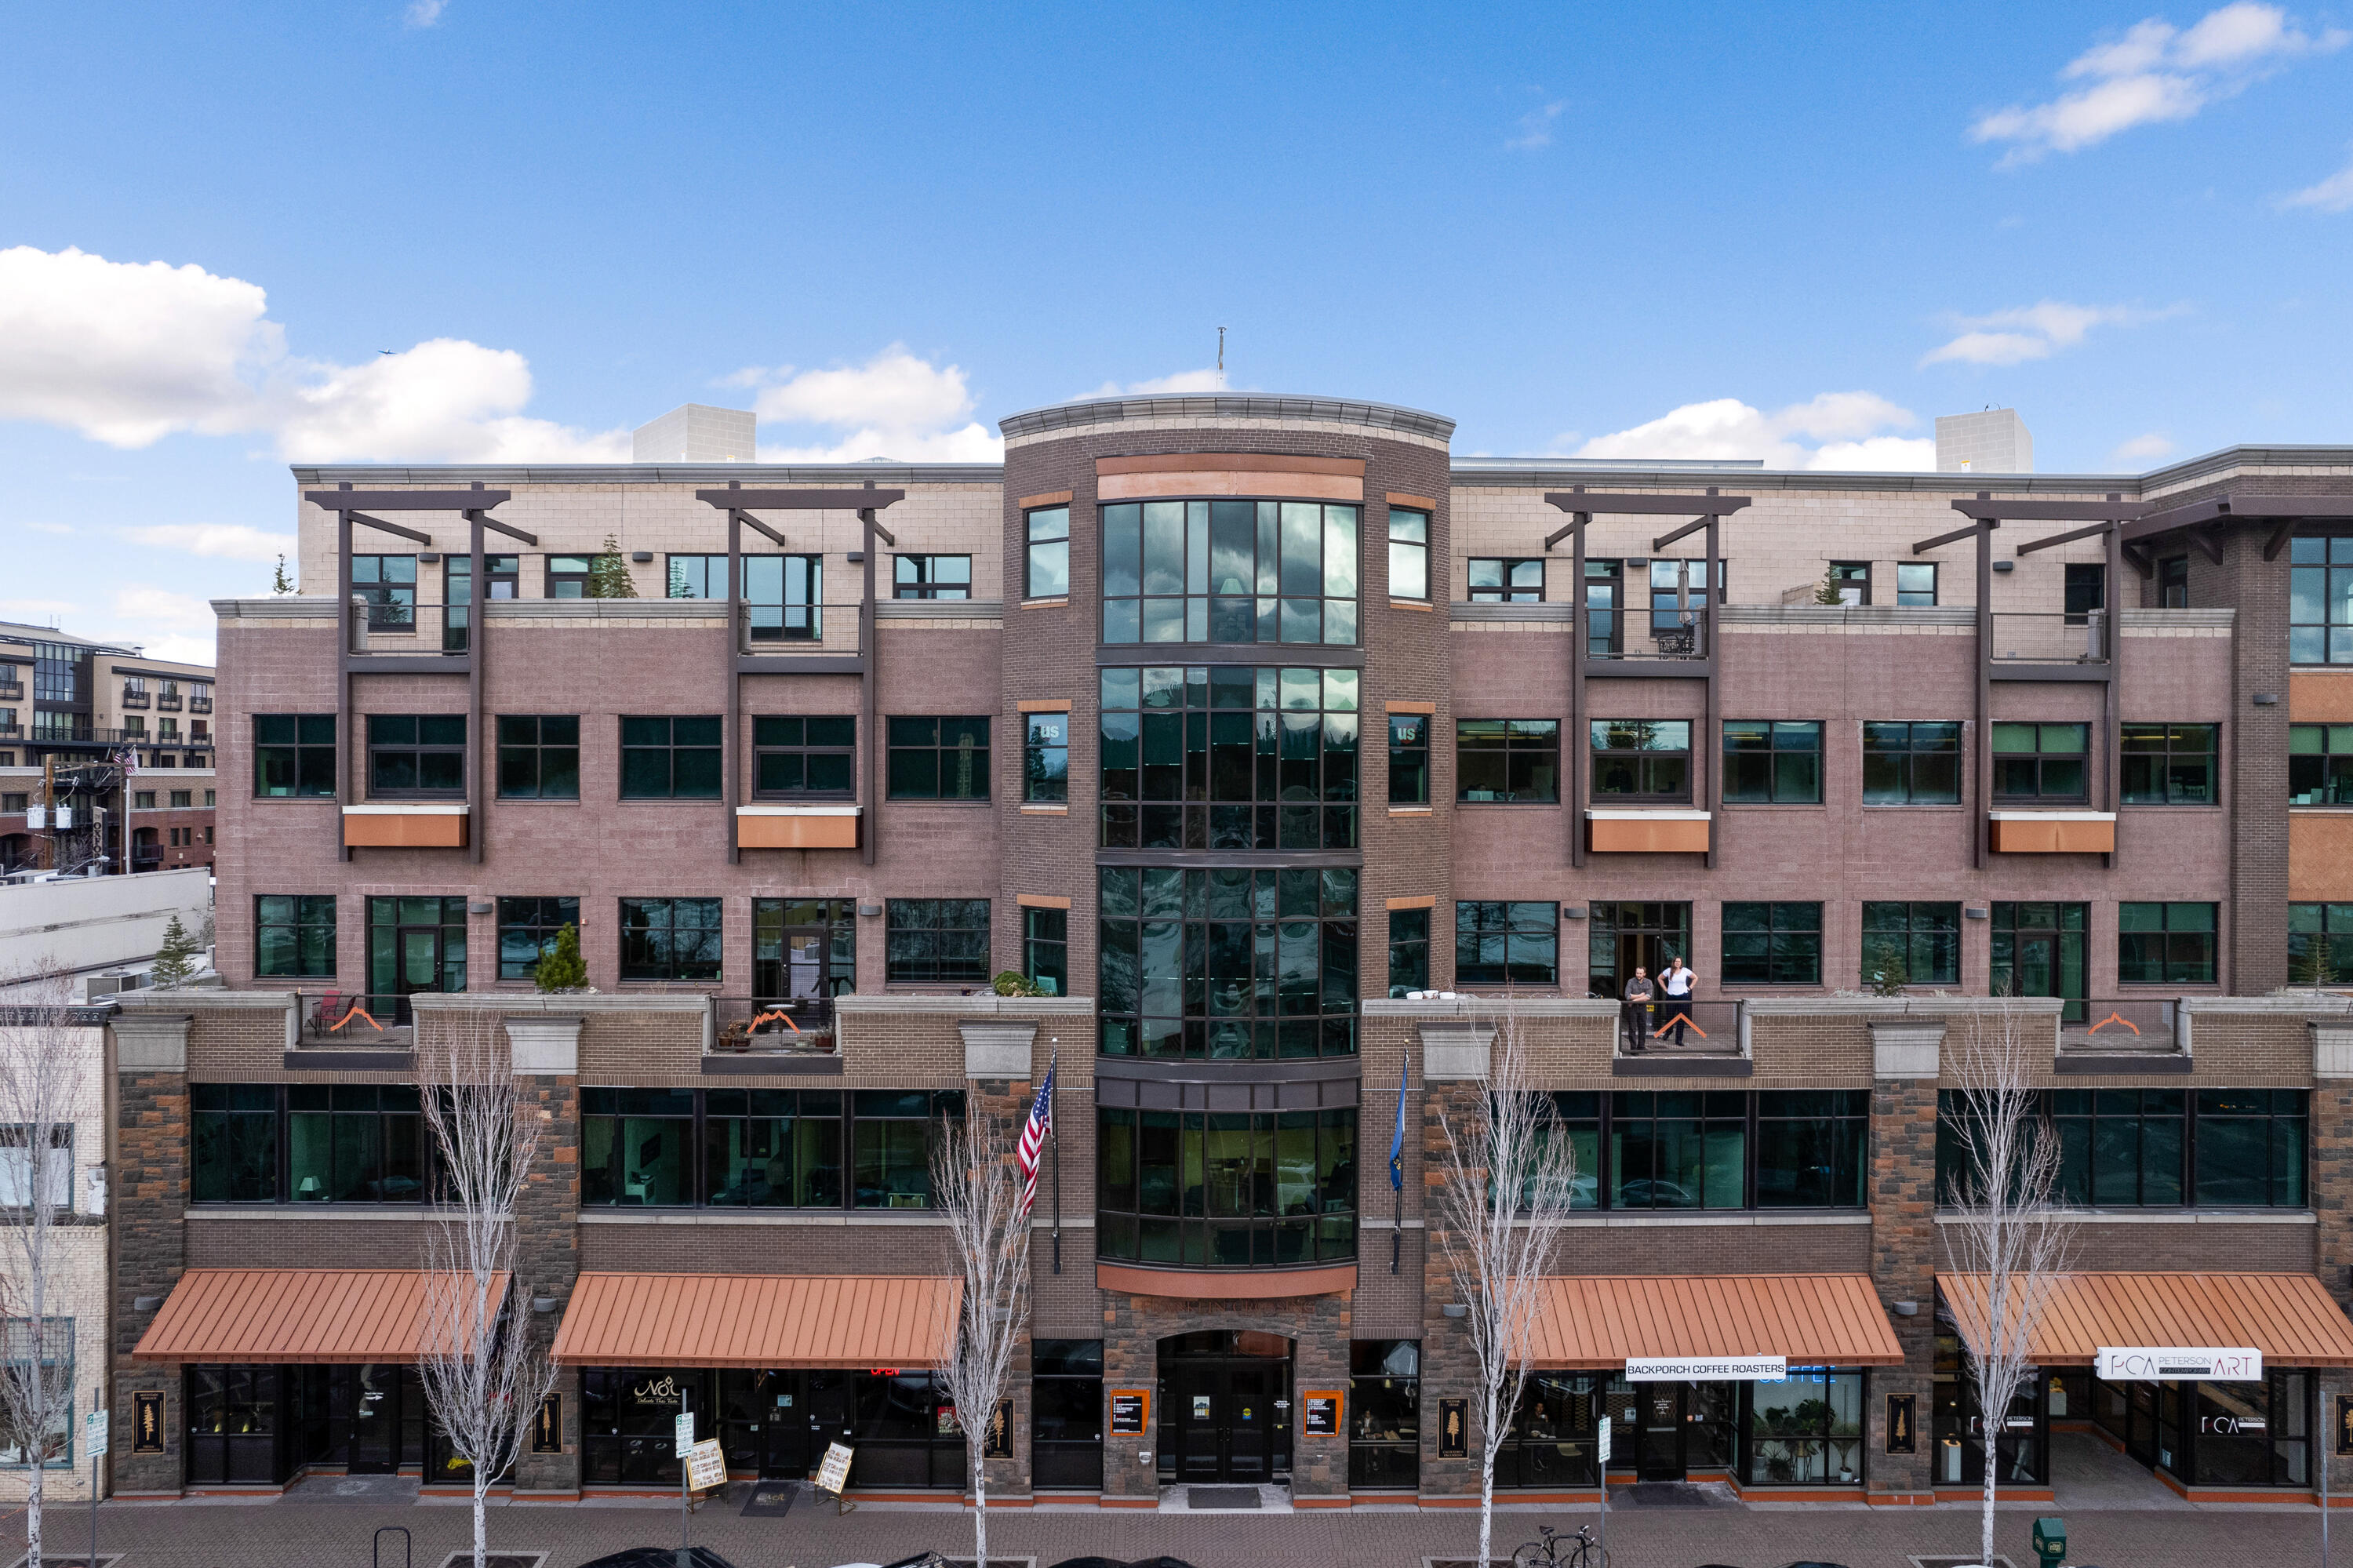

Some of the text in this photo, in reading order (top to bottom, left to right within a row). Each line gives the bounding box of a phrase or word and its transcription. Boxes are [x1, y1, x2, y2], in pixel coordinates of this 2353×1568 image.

[1041, 726, 1059, 738] us
[1398, 727, 1415, 740] us
[1141, 1299, 1315, 1313] FRANKLIN CROSSING
[2111, 1355, 2155, 1375] PCA
[2158, 1356, 2212, 1365] PETERSON
[2213, 1357, 2253, 1375] ART
[1627, 1364, 1784, 1374] BACKPORCH COFFEE ROASTERS
[2202, 1417, 2239, 1434] PCA
